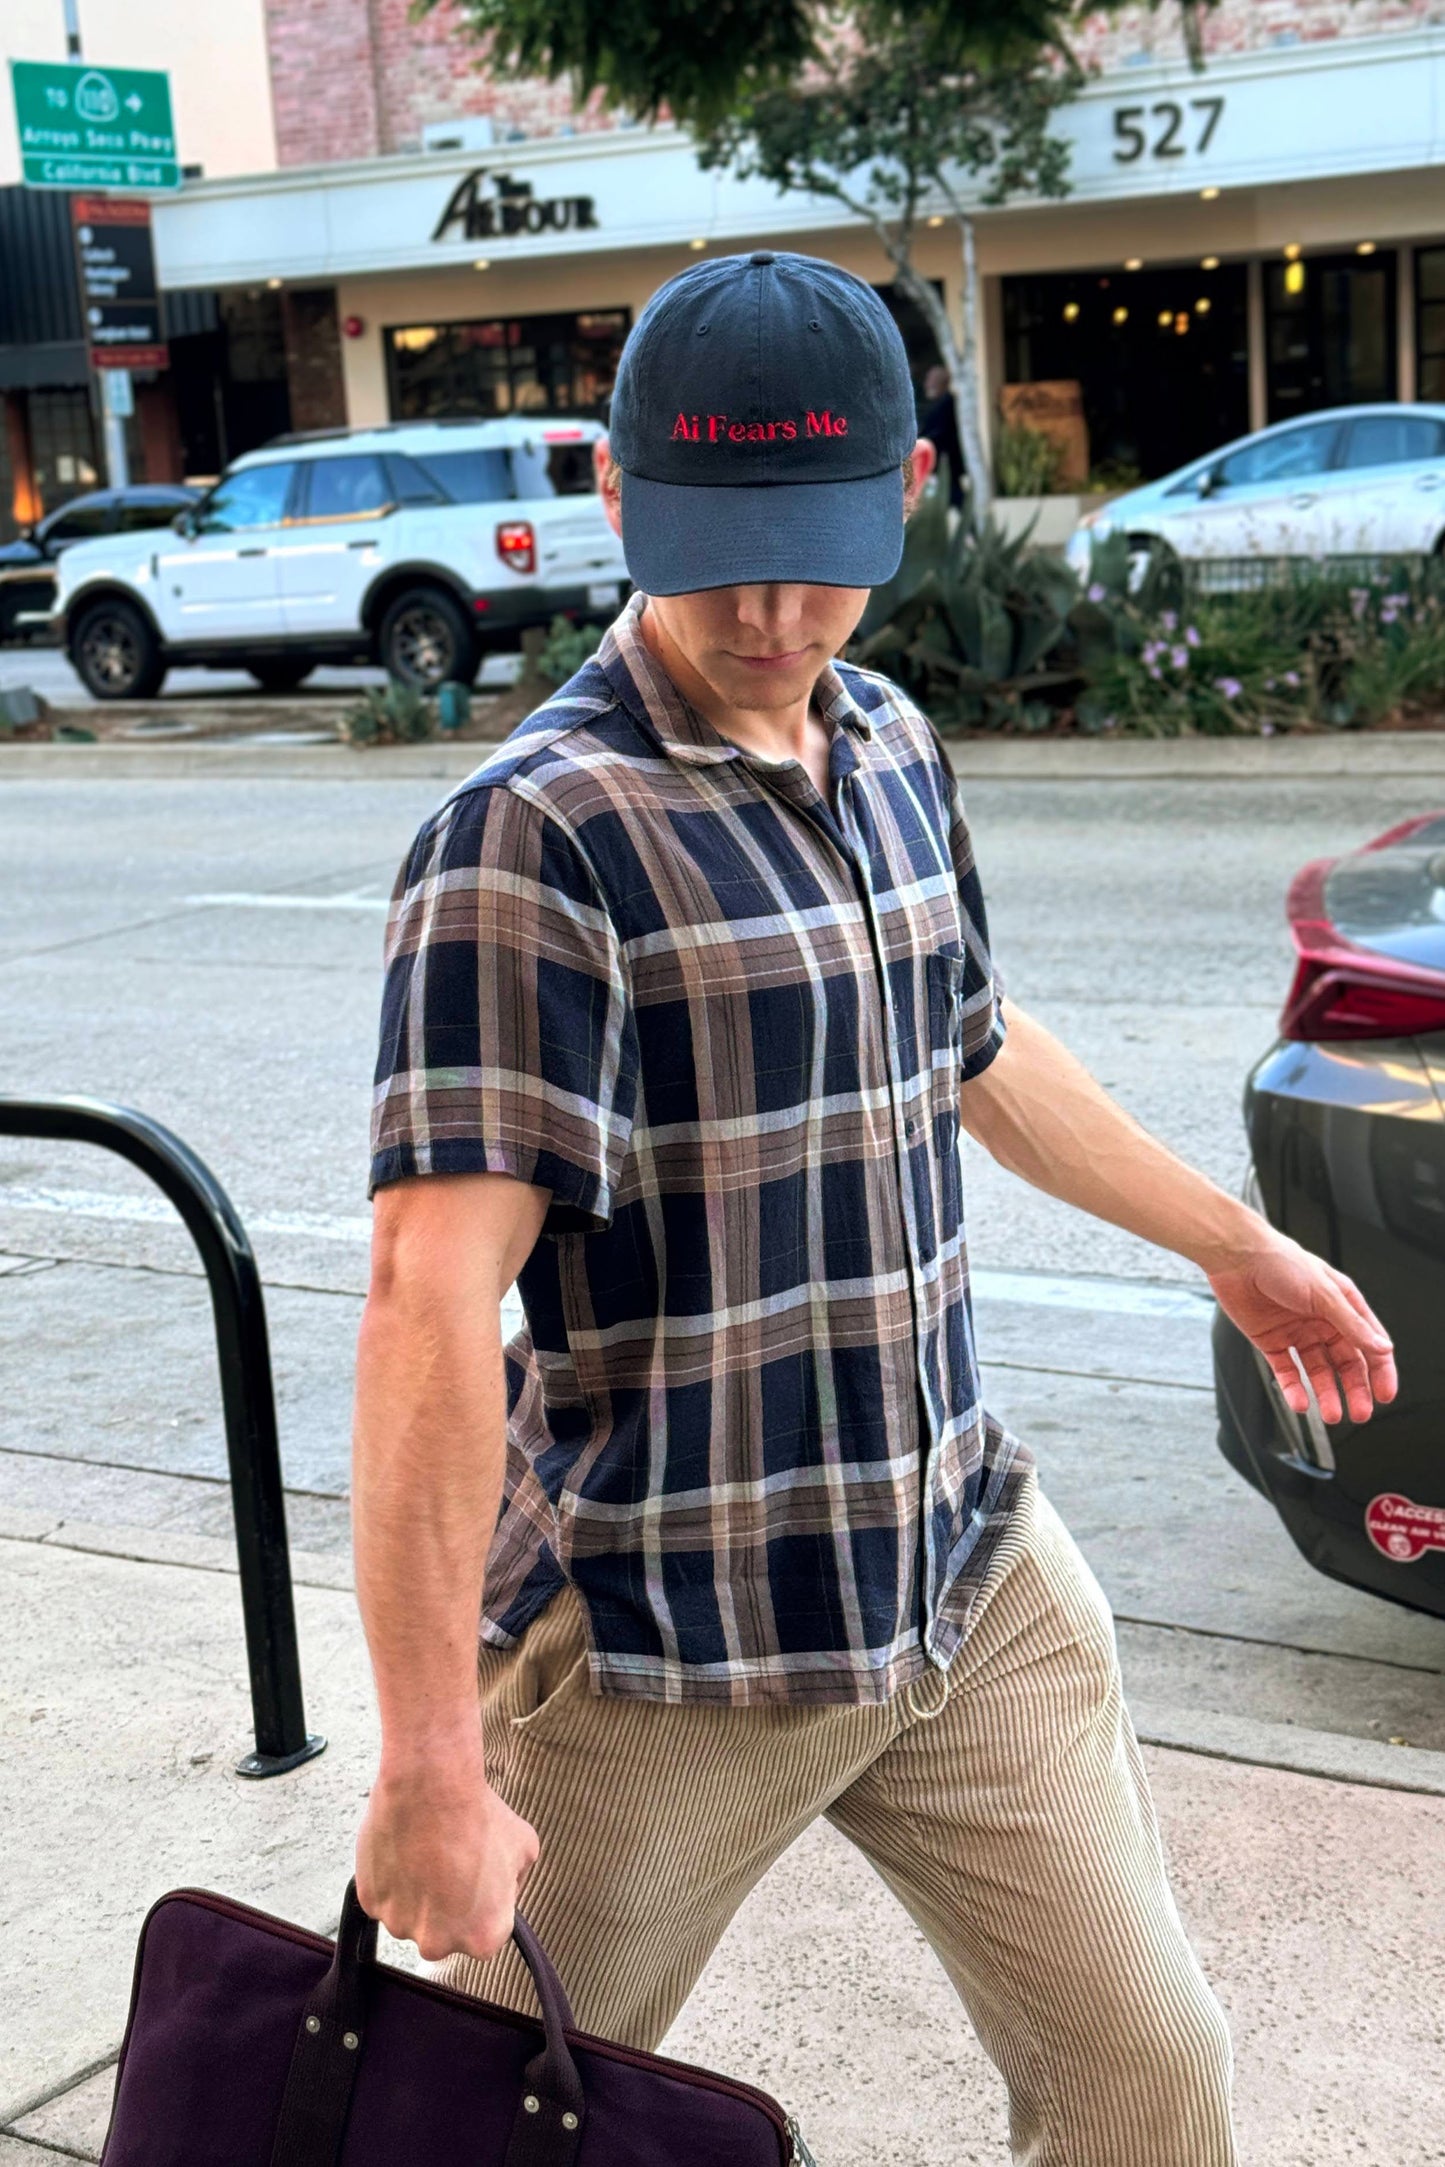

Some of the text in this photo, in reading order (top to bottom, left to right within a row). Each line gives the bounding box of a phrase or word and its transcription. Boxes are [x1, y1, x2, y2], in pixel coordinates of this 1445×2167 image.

[1113, 97, 1224, 162] 527
[43, 161, 161, 184] California Blvd
[670, 409, 848, 443] Ai Fears Me
